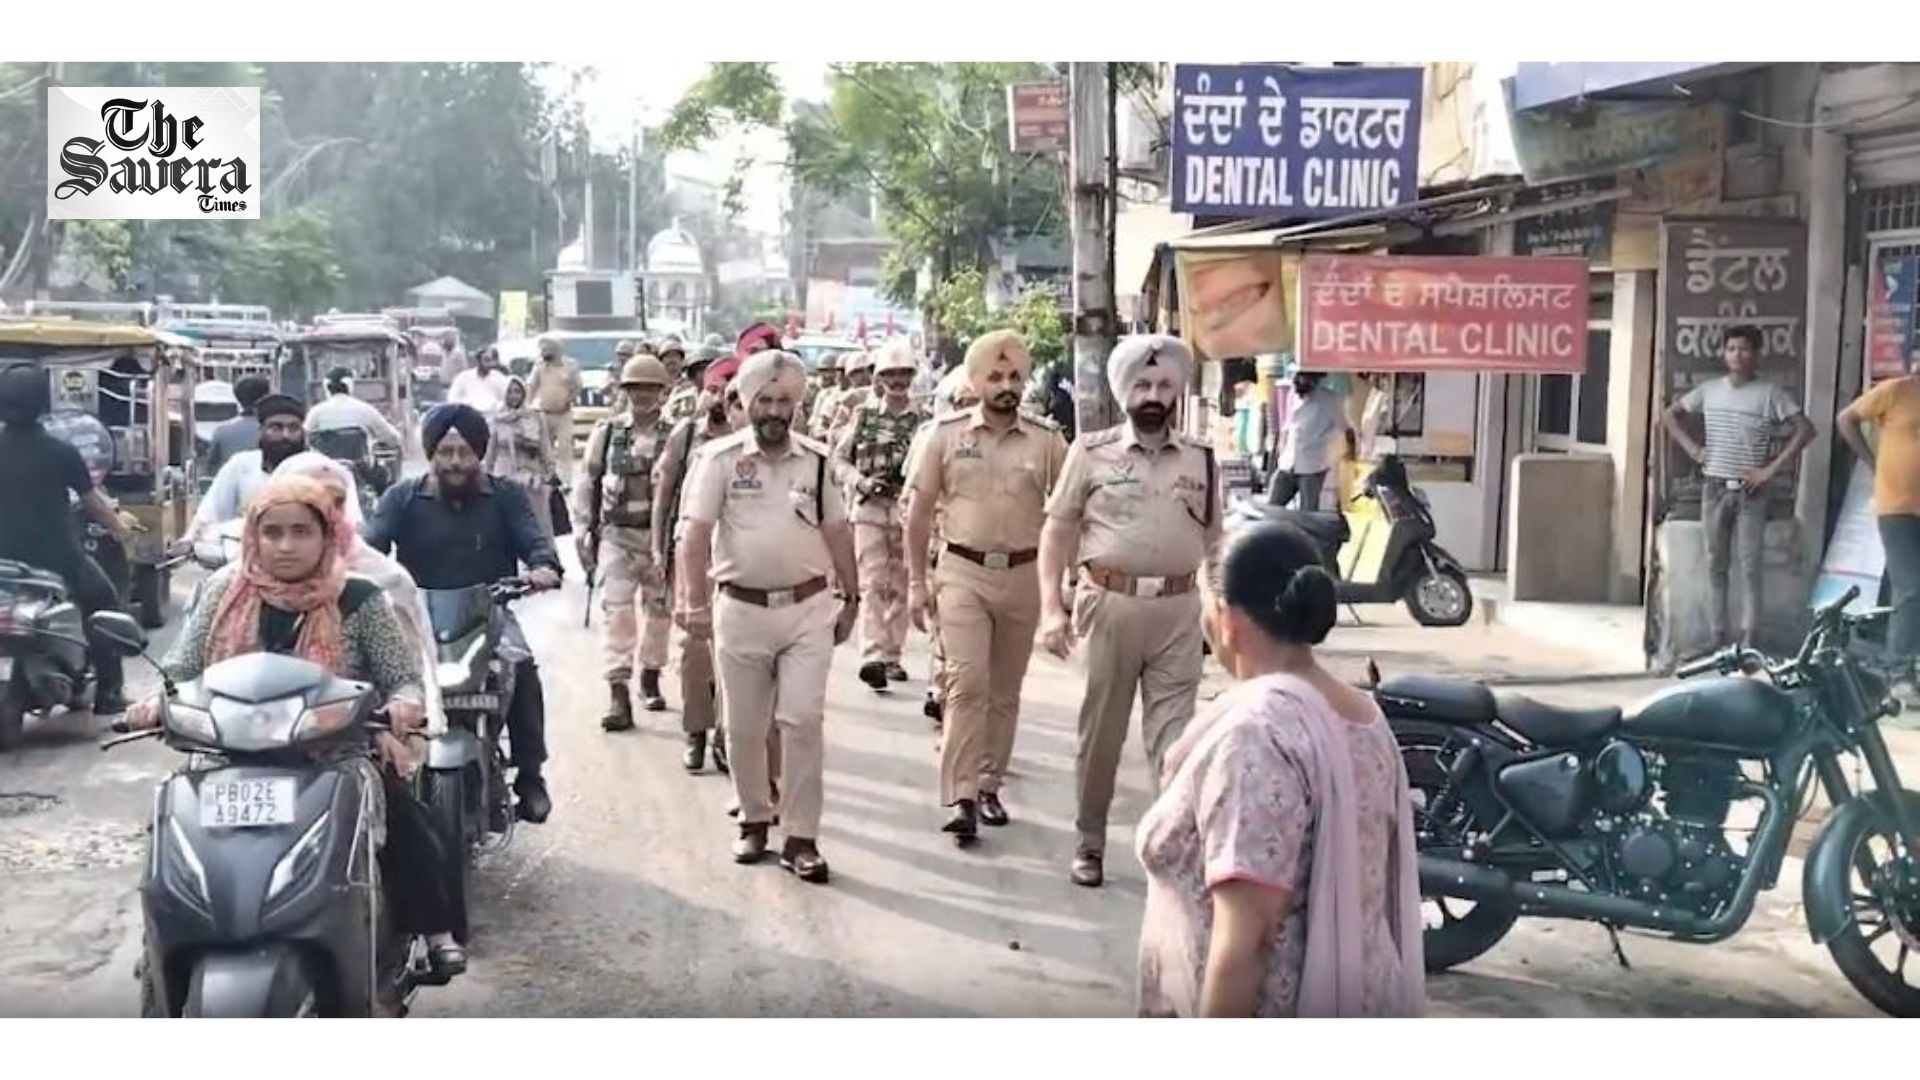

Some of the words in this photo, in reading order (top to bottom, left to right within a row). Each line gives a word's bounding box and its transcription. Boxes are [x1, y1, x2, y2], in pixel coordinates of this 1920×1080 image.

[1183, 72, 1247, 146] ਦੰਦਾਂ
[1258, 76, 1287, 147] ਦੇ
[1300, 97, 1412, 149] ਡਾਕਟਰ
[1185, 155, 1293, 206] DENTAL
[1303, 157, 1400, 208] CLINIC
[1685, 227, 1791, 293] ਡੈਂਟਲ
[1312, 320, 1449, 355] DENTAL
[1460, 322, 1574, 357] CLINIC
[215, 782, 275, 802] PB02E
